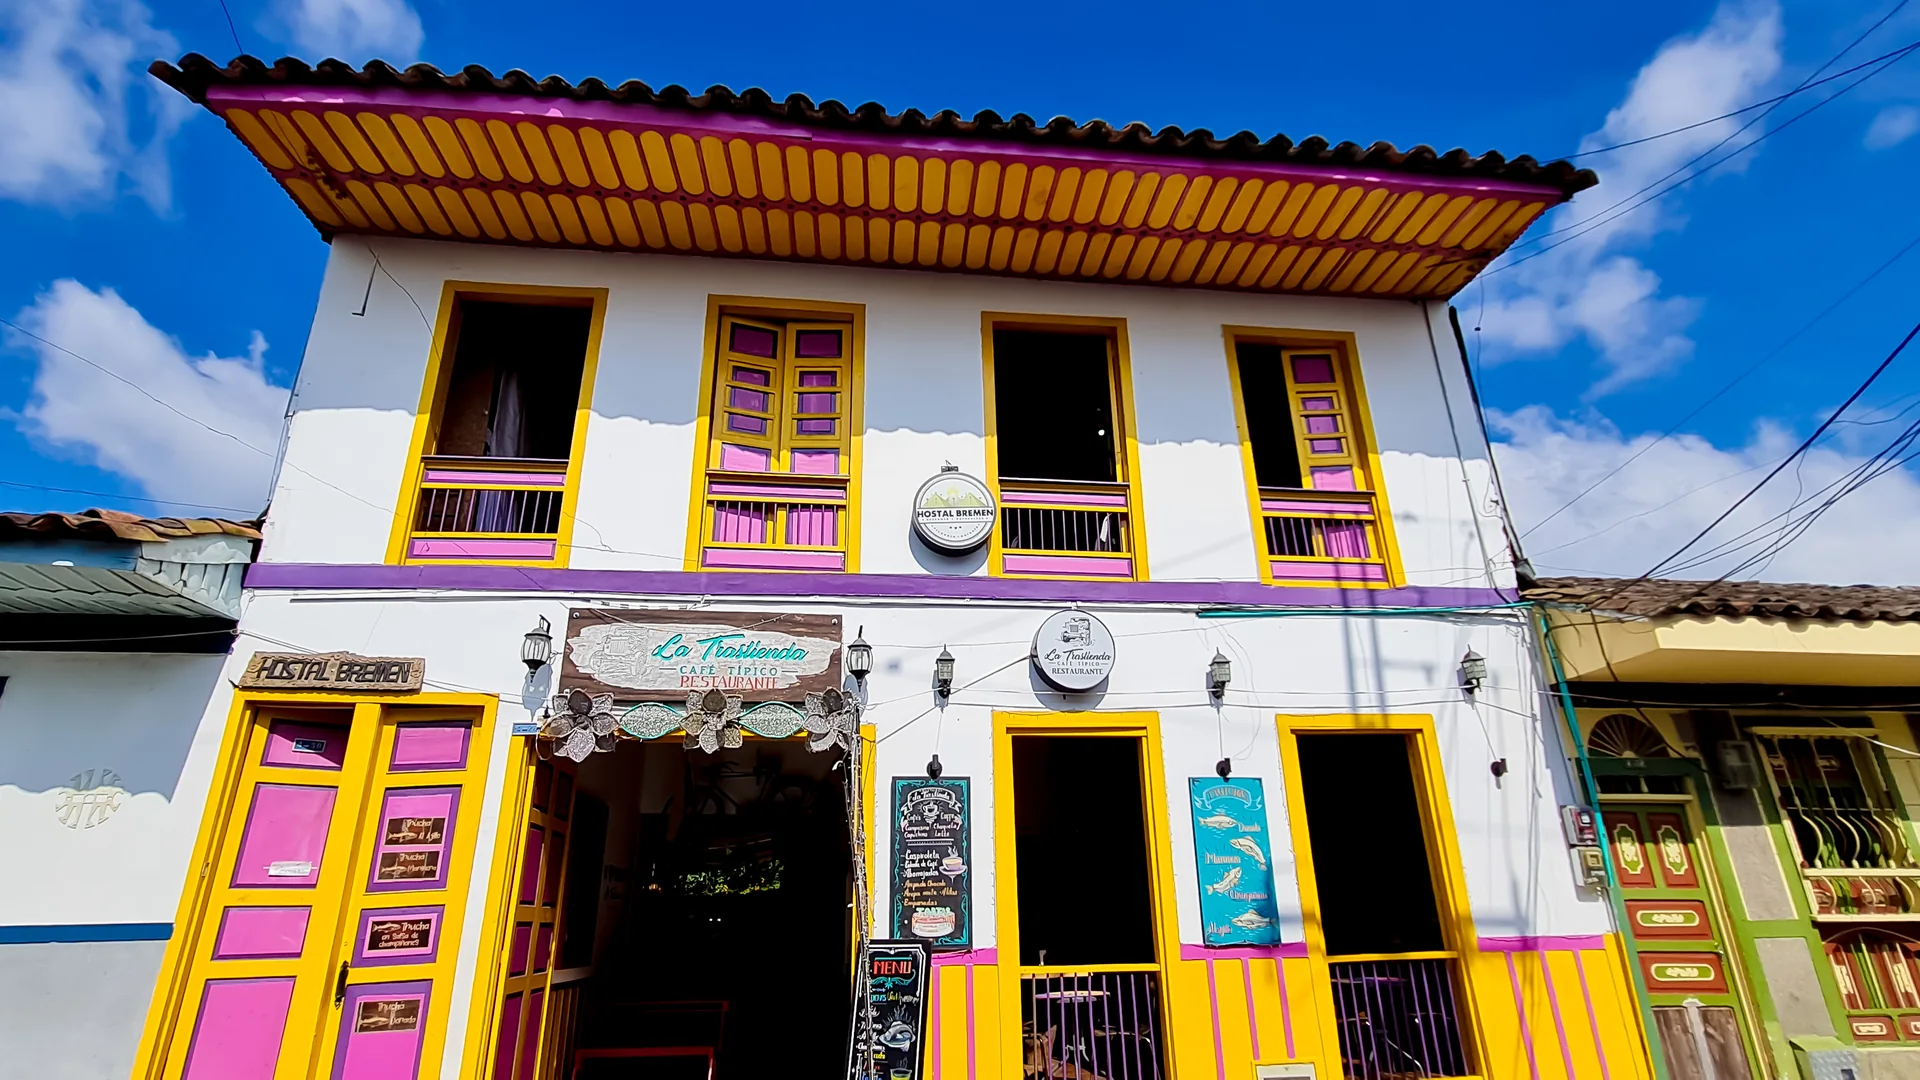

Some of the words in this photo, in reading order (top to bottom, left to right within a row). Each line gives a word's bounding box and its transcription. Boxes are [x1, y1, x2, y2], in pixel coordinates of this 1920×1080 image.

[917, 509, 954, 518] HOSTAL
[956, 509, 994, 517] BREMEN
[651, 633, 692, 658] La
[696, 633, 809, 661] Trastienda
[1044, 648, 1061, 661] La
[1062, 648, 1111, 661] Trastienda
[256, 658, 330, 682] HOSTAL
[335, 660, 413, 683] BREMEN
[679, 664, 716, 675] CAFÉ
[728, 664, 778, 676] TÍPICO
[1051, 667, 1104, 675] RESTAURANTE
[679, 675, 780, 690] RESTAURANTE
[399, 853, 425, 862] Trucha
[401, 921, 430, 931] Trucha
[873, 961, 912, 975] MENU
[377, 1001, 405, 1013] Trucha
